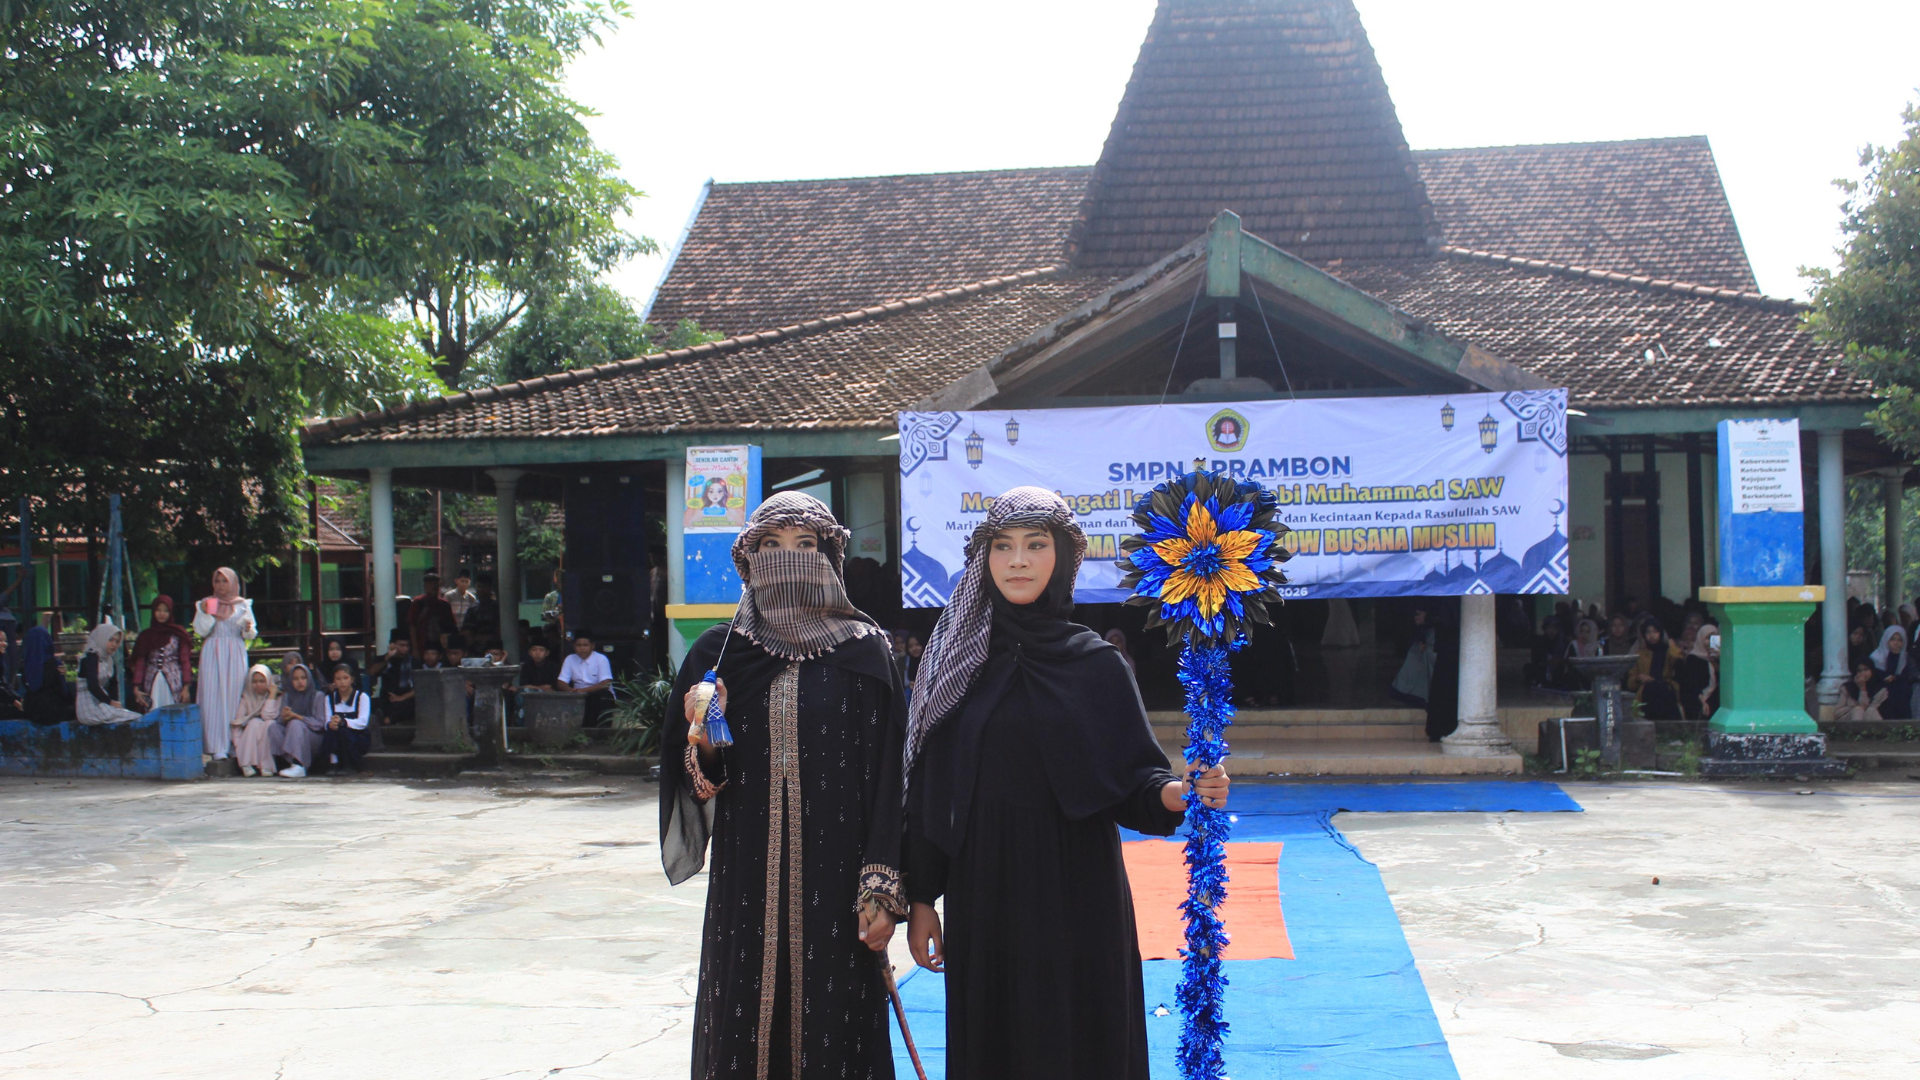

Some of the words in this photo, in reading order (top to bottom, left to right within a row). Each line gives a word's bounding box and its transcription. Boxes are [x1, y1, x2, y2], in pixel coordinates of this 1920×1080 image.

[1108, 461, 1184, 482] SMPN
[1211, 456, 1351, 478] PRAMBON
[1305, 479, 1446, 505] Muhammad
[1448, 476, 1505, 501] SAW
[945, 520, 973, 531] Mari
[1105, 518, 1128, 529] dan
[1284, 513, 1307, 524] dan
[1310, 512, 1372, 523] Kecintaan
[1375, 509, 1422, 522] Kepada
[1425, 506, 1489, 519] Rasulullah
[1492, 504, 1522, 516] SAW
[1323, 525, 1410, 555] BUSANA
[1411, 522, 1497, 552] MUSLIM
[1278, 586, 1309, 598] 2026
